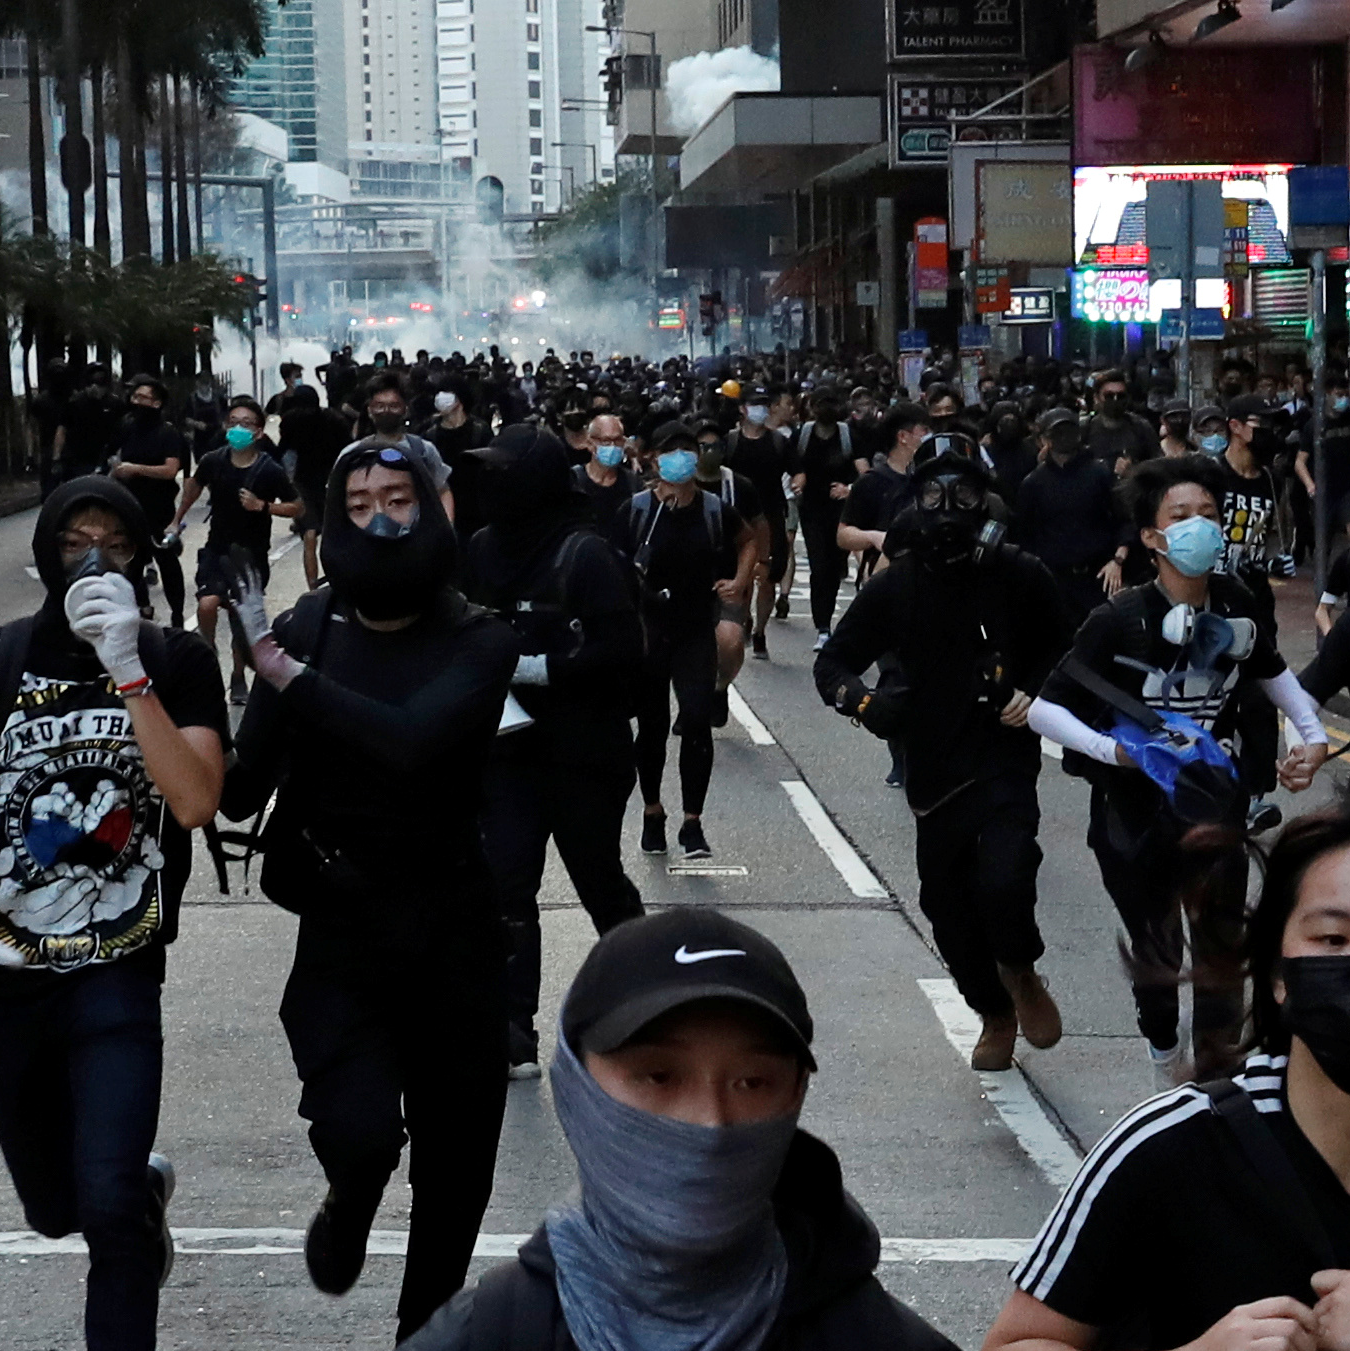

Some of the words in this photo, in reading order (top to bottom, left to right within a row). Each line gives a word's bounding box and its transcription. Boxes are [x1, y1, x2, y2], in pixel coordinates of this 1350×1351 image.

[903, 36, 945, 48] TALENT
[949, 36, 1014, 47] PHARMACY
[1223, 491, 1273, 513] FREE
[93, 714, 135, 737] THA
